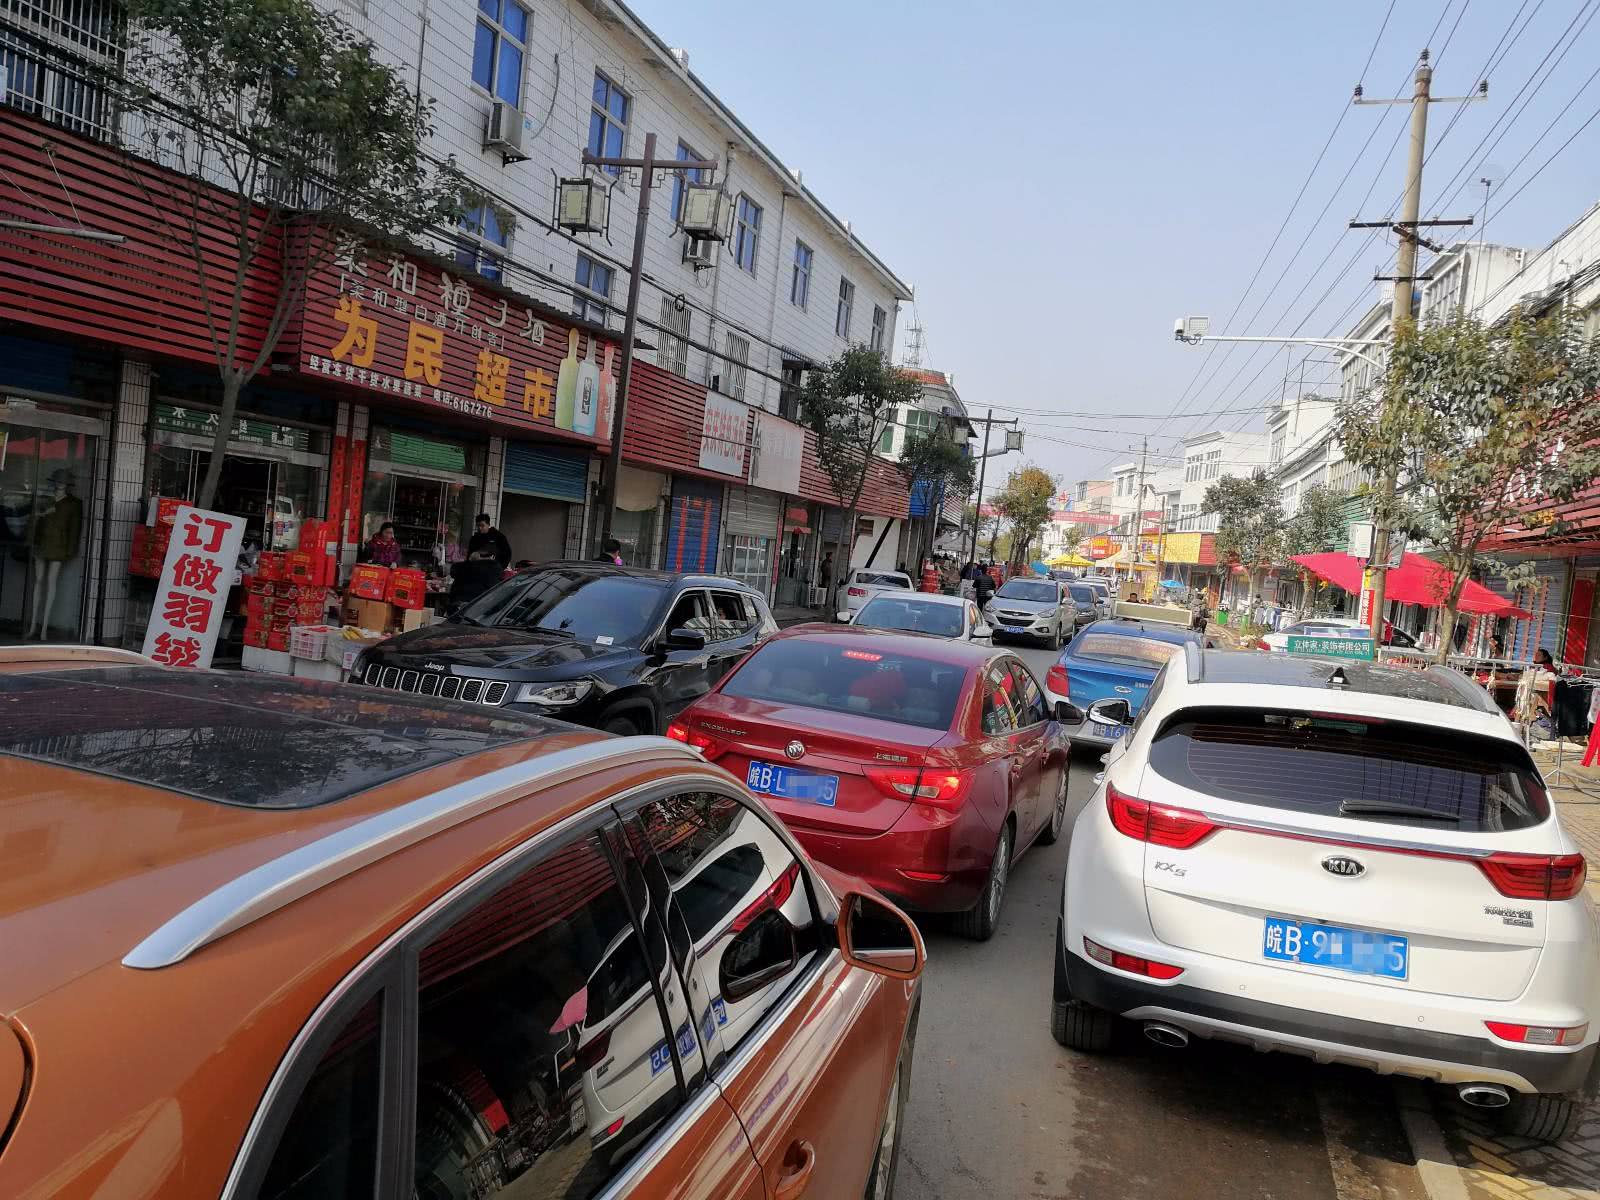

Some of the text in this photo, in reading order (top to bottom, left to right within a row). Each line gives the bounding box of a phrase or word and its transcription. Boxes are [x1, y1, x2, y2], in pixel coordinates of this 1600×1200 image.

[331, 293, 554, 419] 为民超市
[152, 512, 233, 668] 订做羽绒
[424, 661, 445, 672] Jeep
[1328, 859, 1358, 875] KIA
